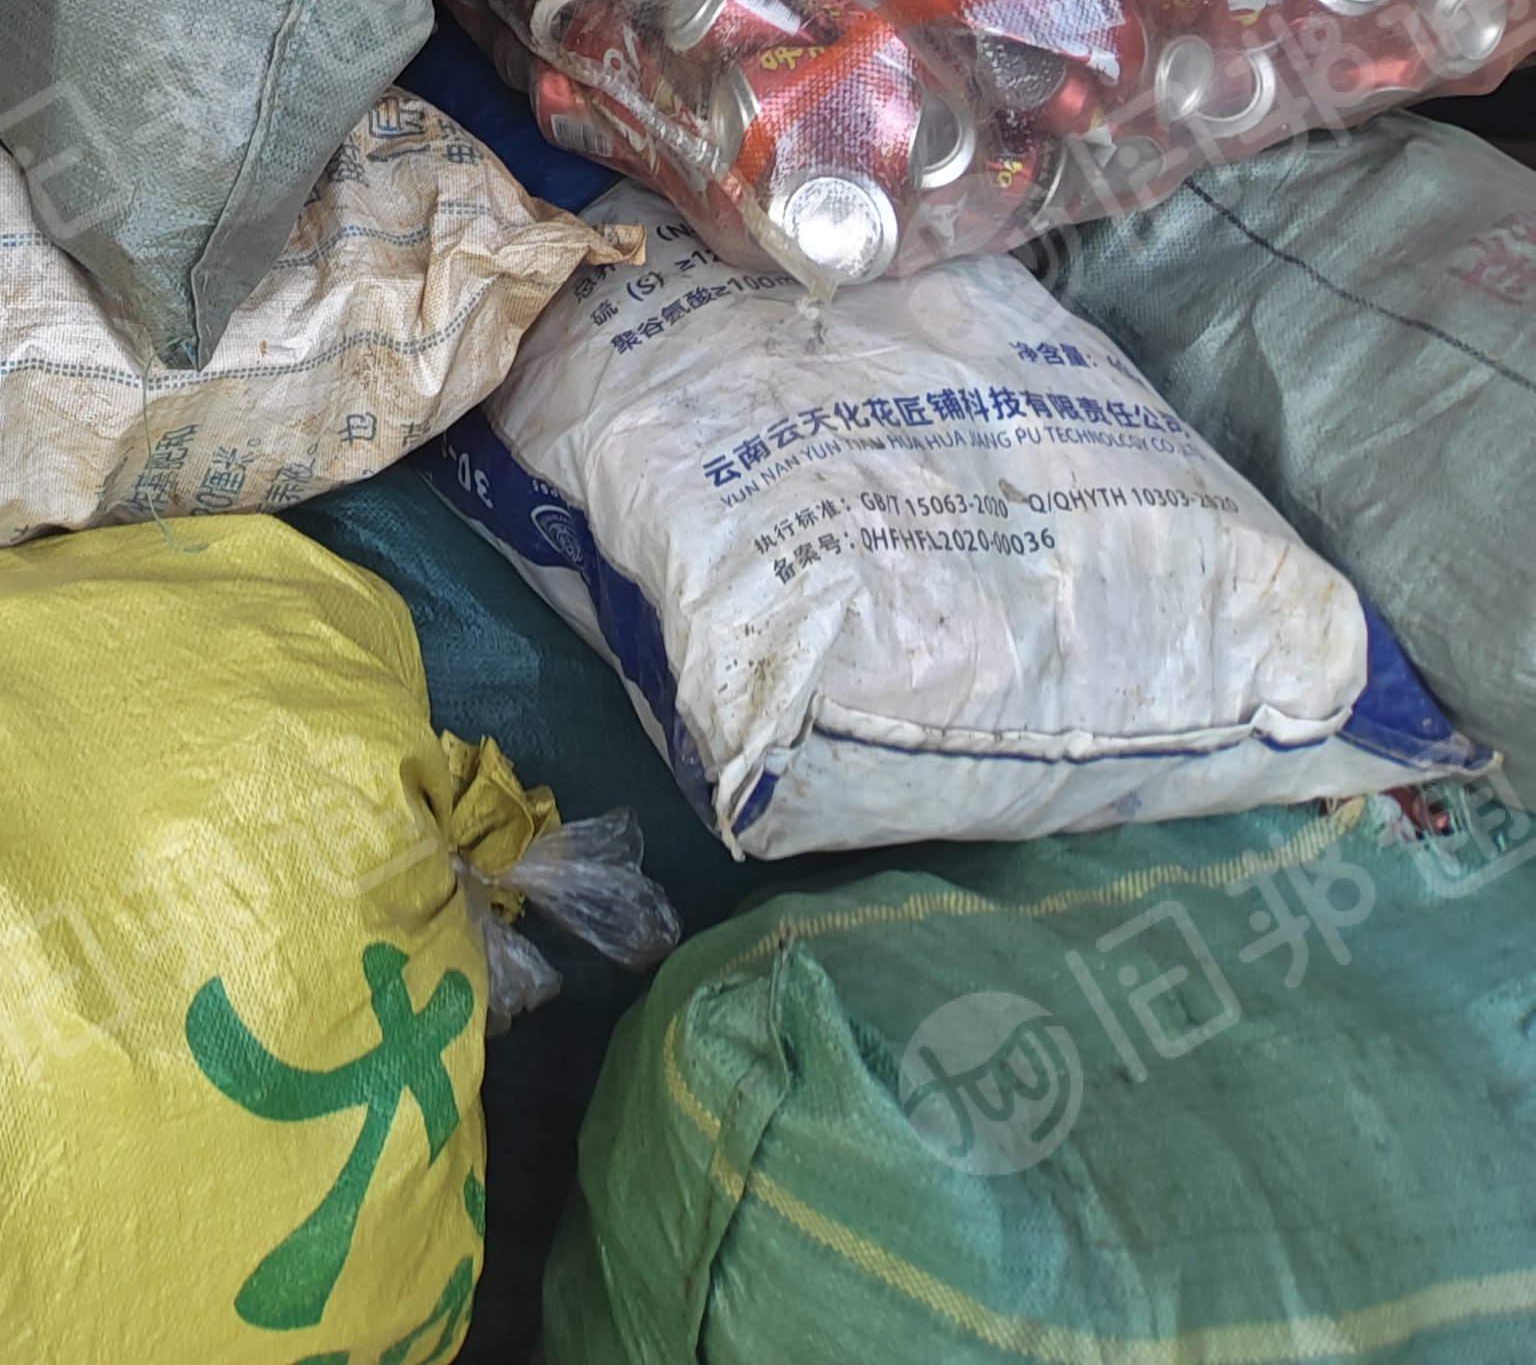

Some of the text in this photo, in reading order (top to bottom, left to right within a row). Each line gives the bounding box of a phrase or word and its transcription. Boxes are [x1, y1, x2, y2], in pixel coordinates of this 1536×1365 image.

[763, 455, 801, 485] NAN
[803, 438, 842, 462] YUN
[1014, 426, 1042, 446] PU
[860, 491, 900, 515] GB/T
[905, 493, 1010, 520] 15063-2020
